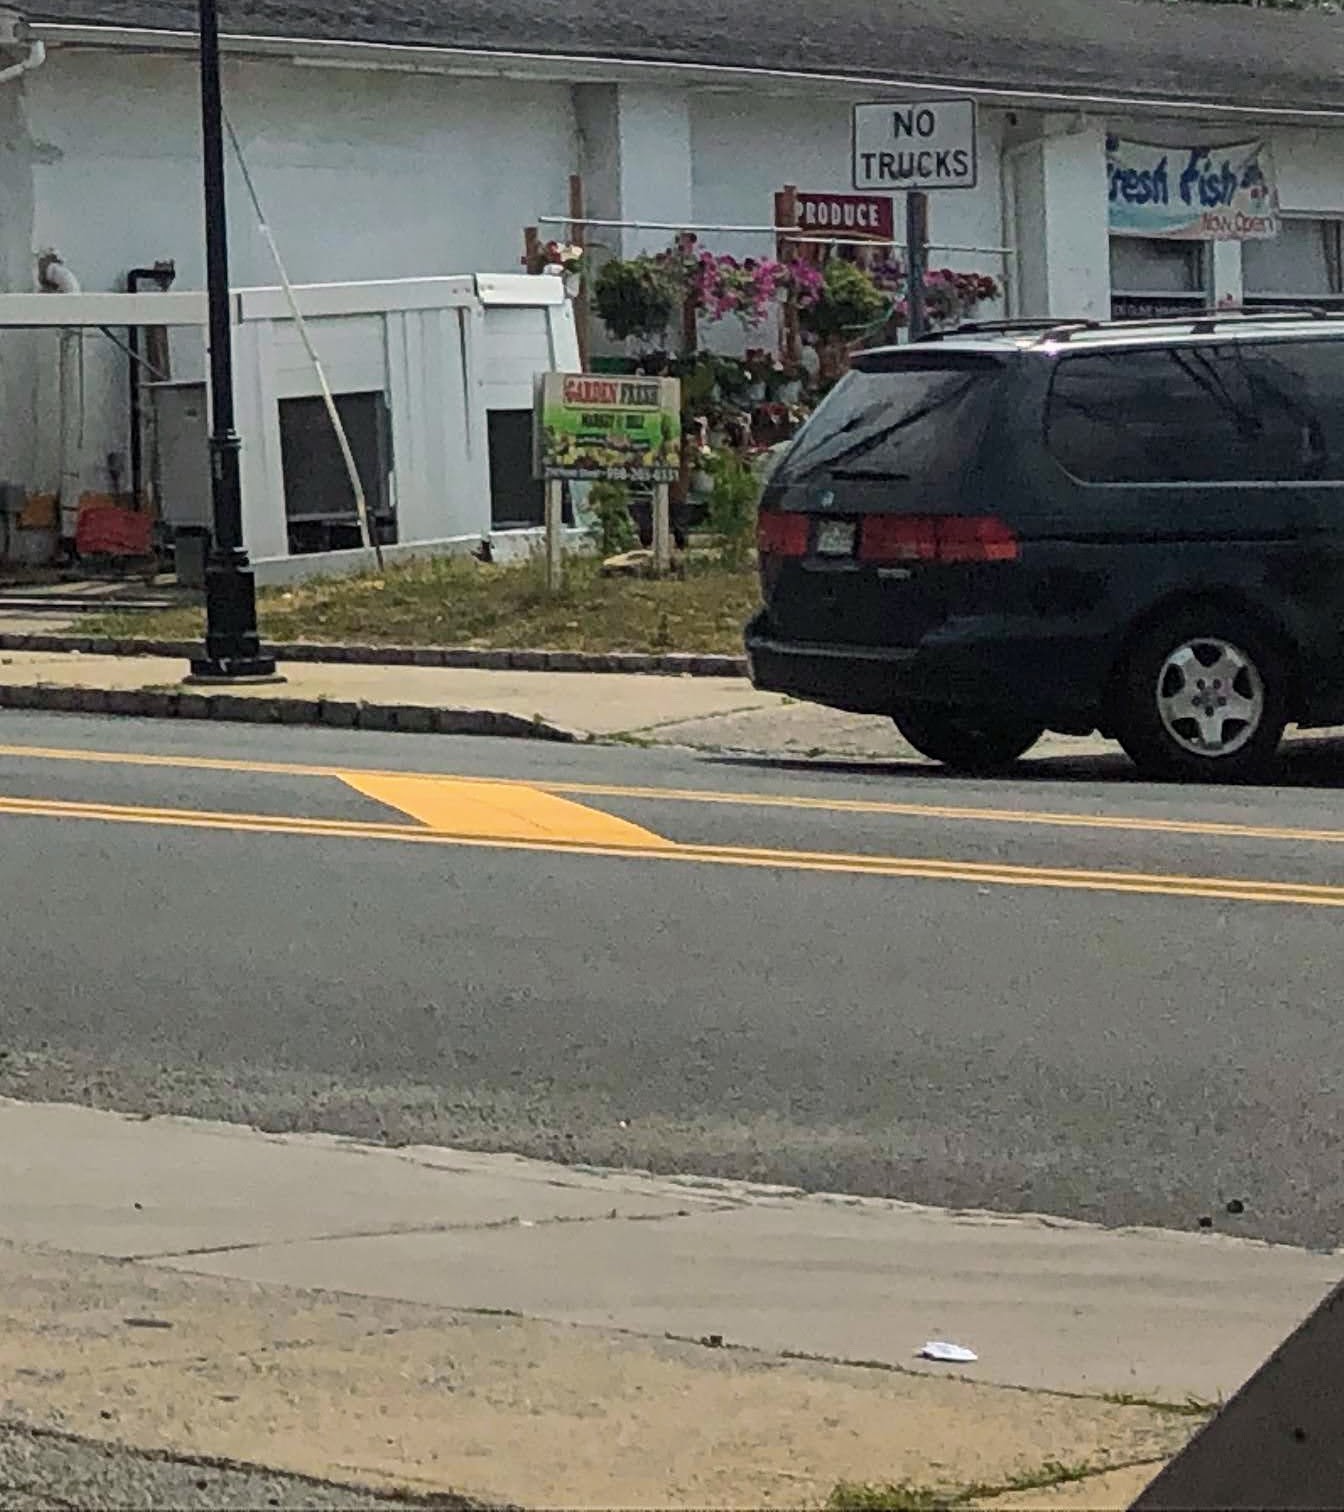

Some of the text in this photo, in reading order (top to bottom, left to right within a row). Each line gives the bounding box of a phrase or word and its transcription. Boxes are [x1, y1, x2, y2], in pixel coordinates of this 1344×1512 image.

[893, 109, 935, 138] NO
[860, 150, 968, 180] TRUCKS
[1106, 138, 1236, 206] resh Fish
[794, 201, 879, 226] PRODUCE
[1235, 211, 1275, 232] Open
